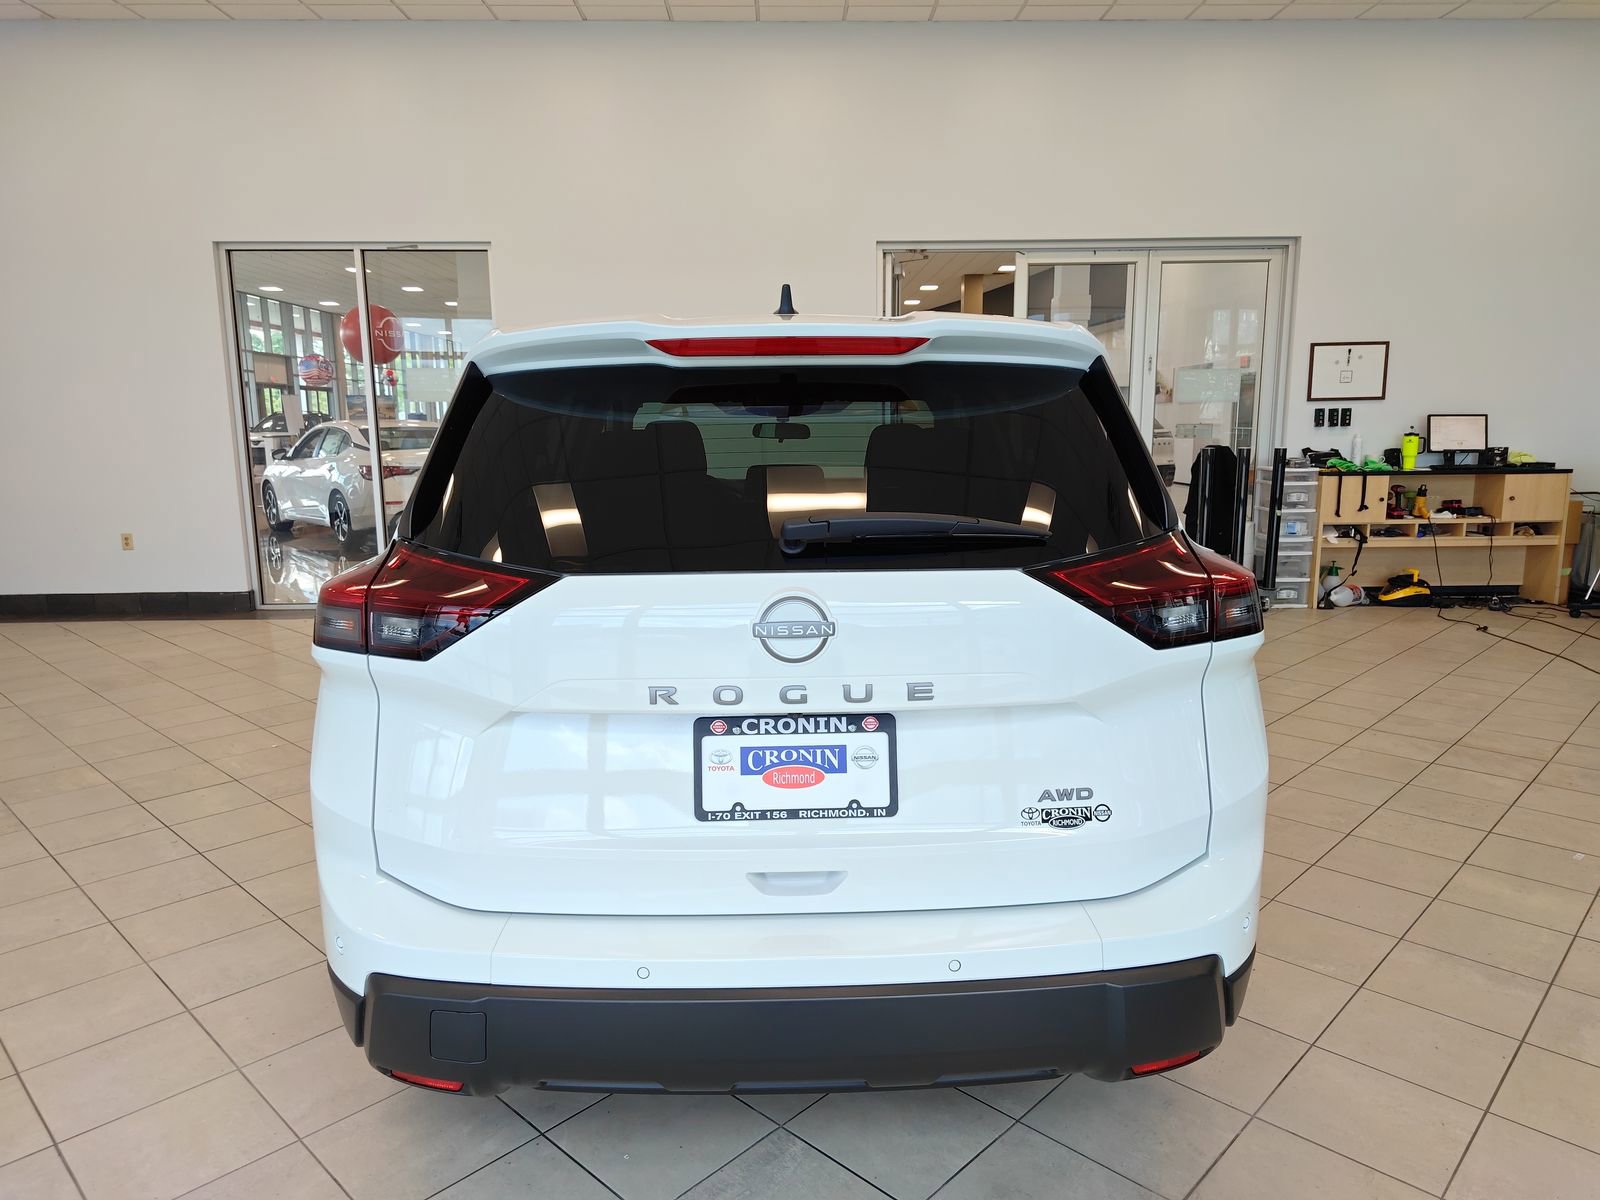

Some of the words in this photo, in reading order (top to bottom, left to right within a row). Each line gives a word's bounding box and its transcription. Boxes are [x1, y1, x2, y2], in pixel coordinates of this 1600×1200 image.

[755, 624, 833, 636] NISSAN
[648, 682, 935, 705] ROGUE
[741, 716, 847, 735] CRONIN
[747, 748, 840, 771] CRONIN
[772, 770, 816, 785] Richmond
[1037, 787, 1094, 802] AWD
[708, 811, 731, 821] I-70
[734, 811, 761, 820] EXIT
[765, 810, 788, 819] 156
[798, 808, 870, 818] RICHMOND,
[873, 808, 886, 817] IN
[1042, 807, 1091, 821] CRONIN
[1052, 818, 1083, 826] RICHMOND
